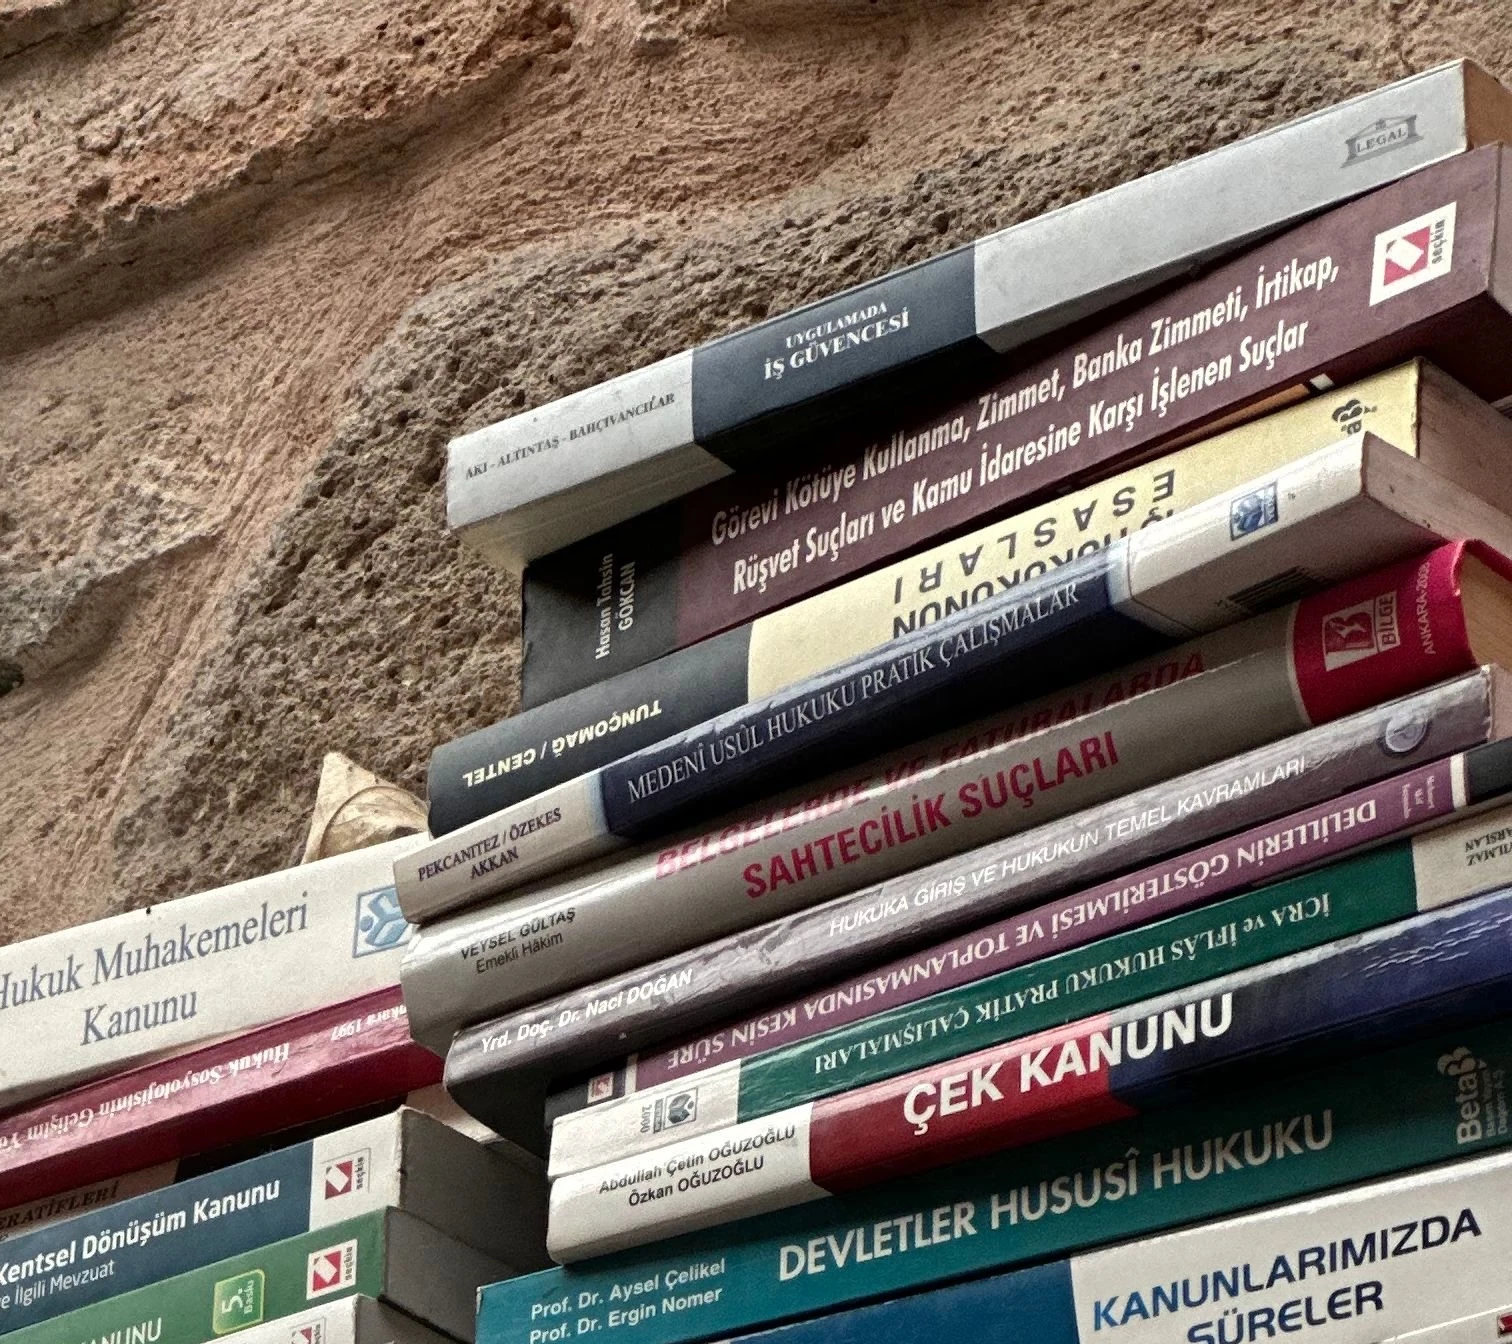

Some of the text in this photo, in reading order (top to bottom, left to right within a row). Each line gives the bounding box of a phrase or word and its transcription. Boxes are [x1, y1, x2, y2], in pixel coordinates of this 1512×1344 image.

[1354, 126, 1408, 155] LEGAL
[764, 308, 910, 382] İŞ GÜVENCESİ
[786, 301, 888, 349] UYGULAMADA
[711, 253, 1340, 546] Görevi Kötüye Kullanma, Zimmet, Banka Zimmeti, İrtikap,
[619, 561, 636, 633] GÖKCAN
[743, 731, 1118, 898] SAHTECİLİK SUÇLARI
[92, 892, 309, 987] Muhakemeleri
[80, 991, 198, 1047] Kanunu
[903, 994, 1234, 1136] ÇEK KANUNU
[82, 1206, 187, 1260] Dönüşüm
[193, 1178, 281, 1223] Kanunu
[780, 1109, 1333, 1282] DEVLETLER HUSUSÎ HUKUKU
[530, 1259, 726, 1320] Prof. Dr. Aysel Çelikel
[1092, 1207, 1483, 1331] KANUNLARIMIZDA
